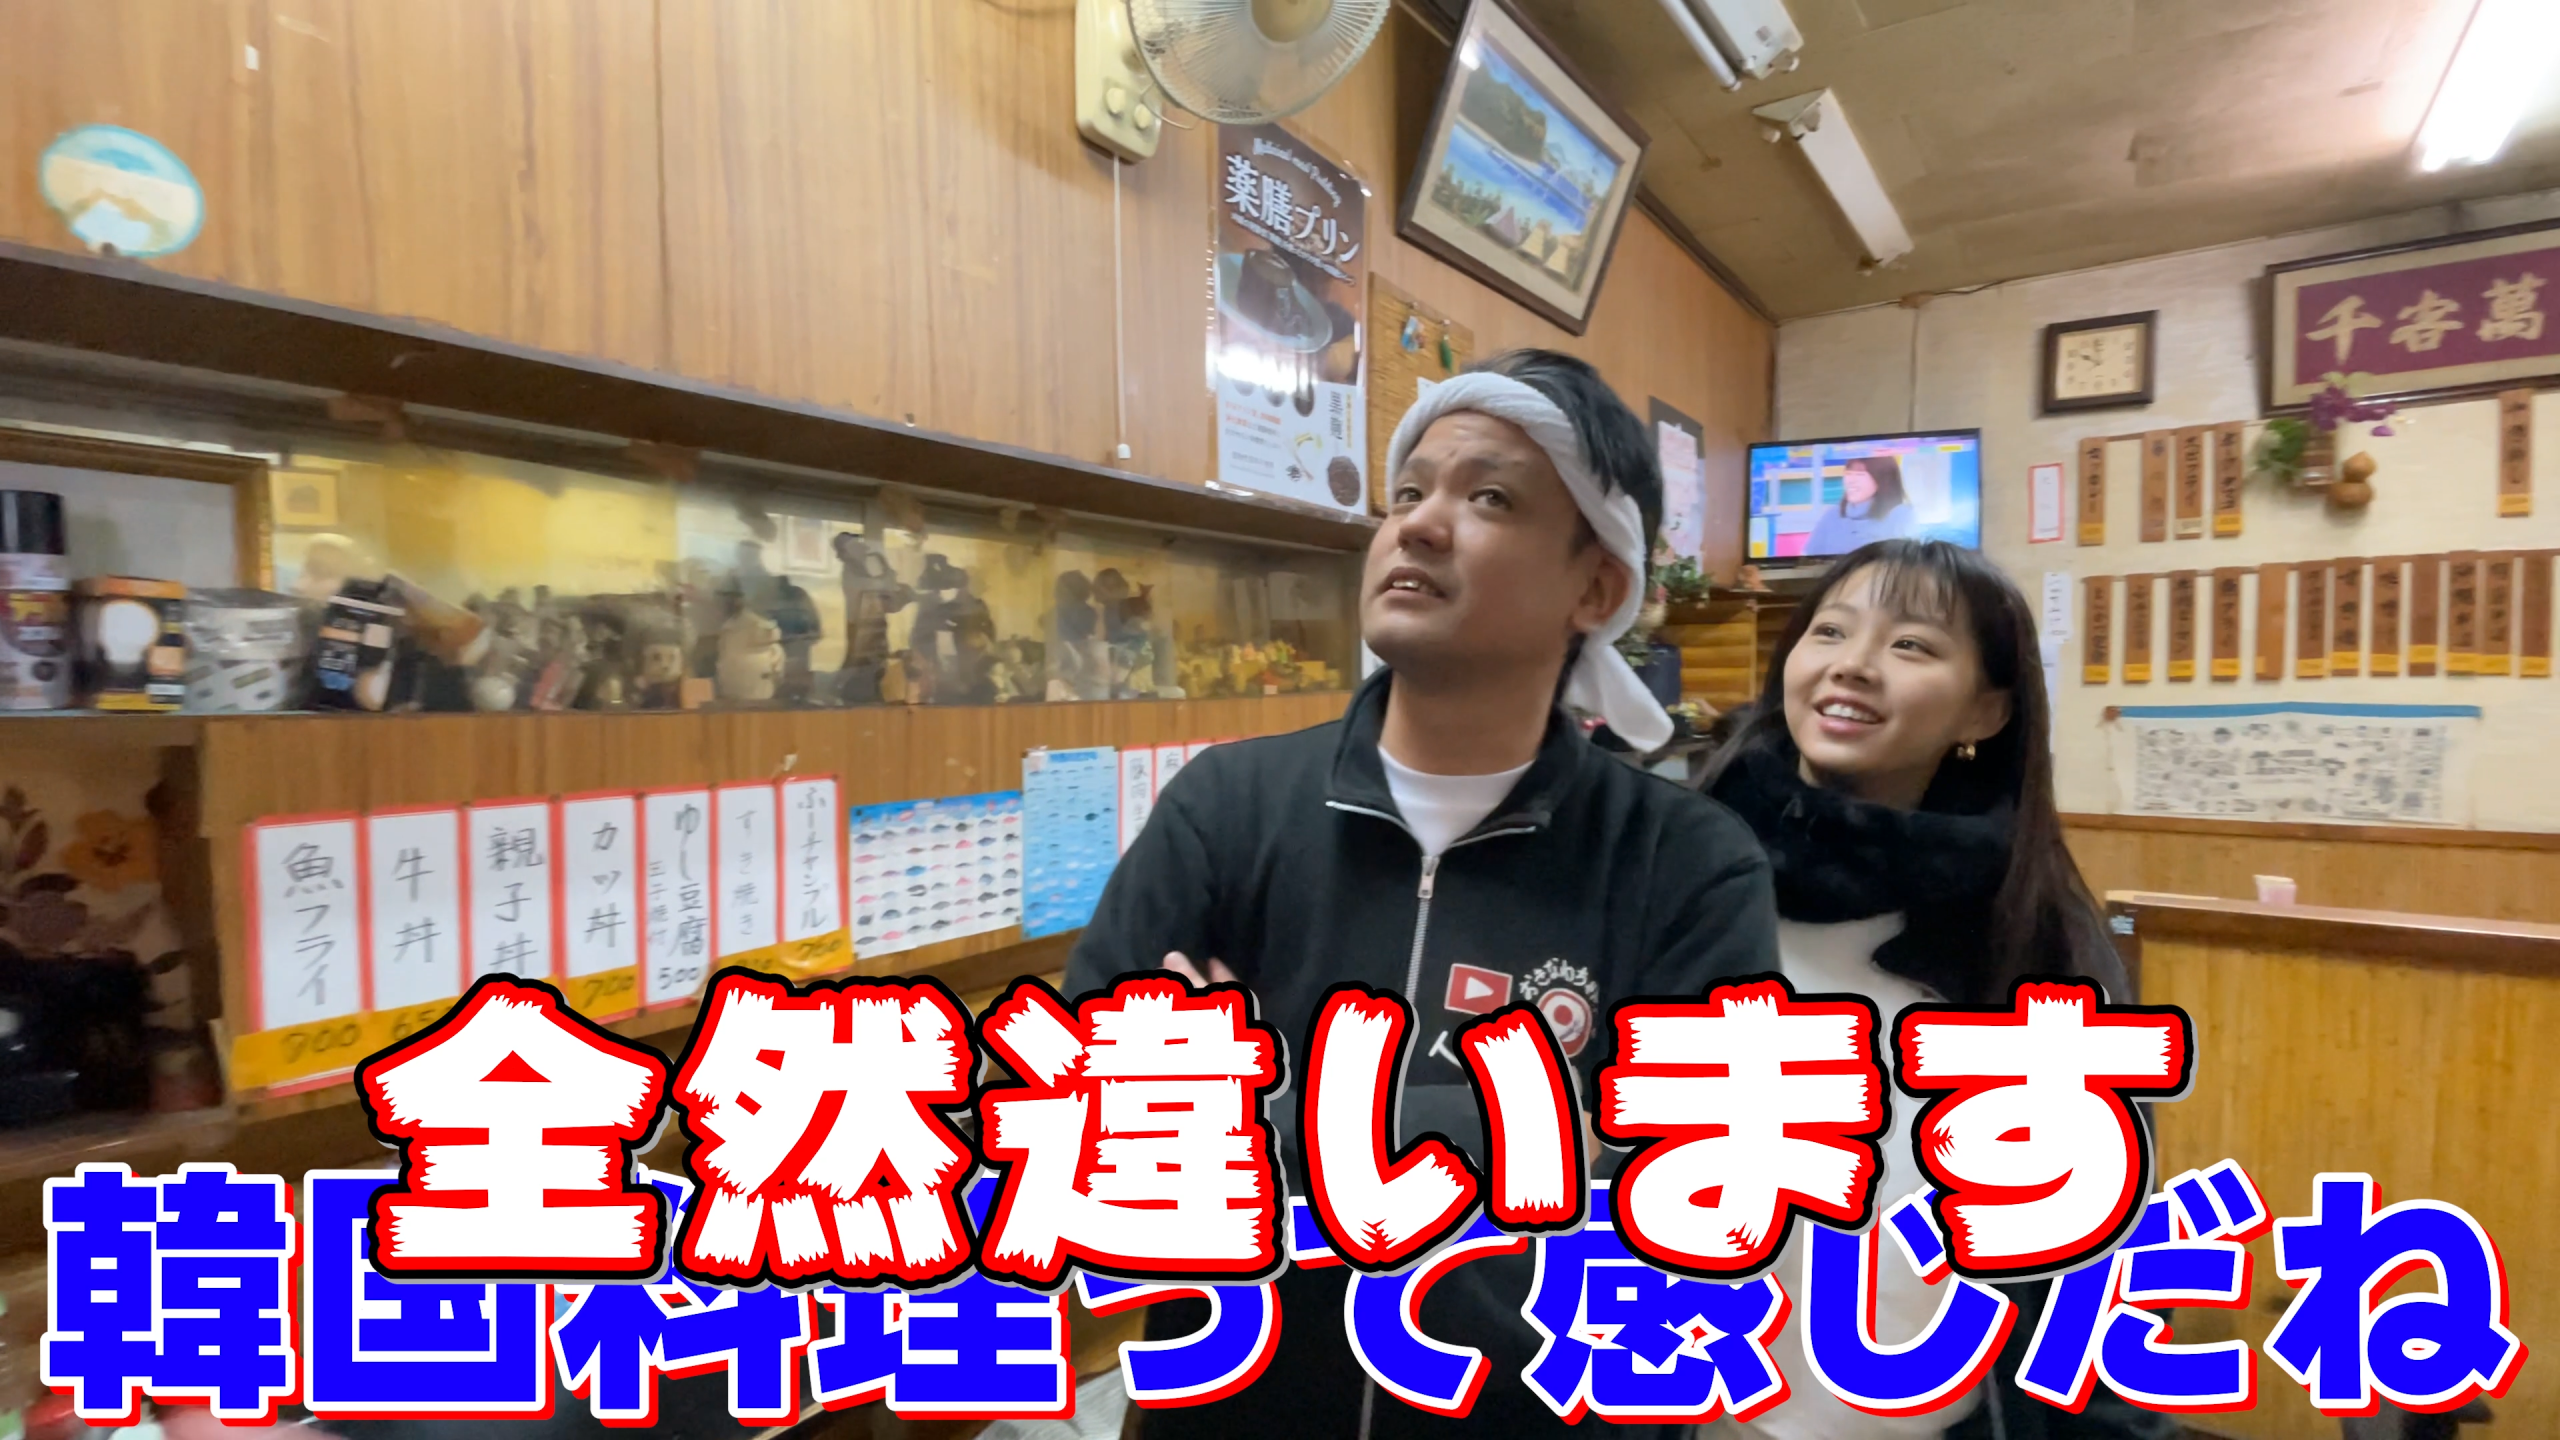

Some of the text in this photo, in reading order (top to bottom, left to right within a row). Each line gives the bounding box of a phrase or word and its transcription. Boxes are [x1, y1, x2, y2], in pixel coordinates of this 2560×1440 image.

[1223, 154, 1359, 263] 薬膳プリン
[280, 841, 345, 1007] 魚フライ
[390, 846, 443, 964] 牛丼
[486, 826, 546, 977] 親子丼
[582, 974, 635, 1010] 700
[658, 965, 702, 991] 500
[280, 1022, 362, 1065] 700
[391, 1003, 454, 1042] 65
